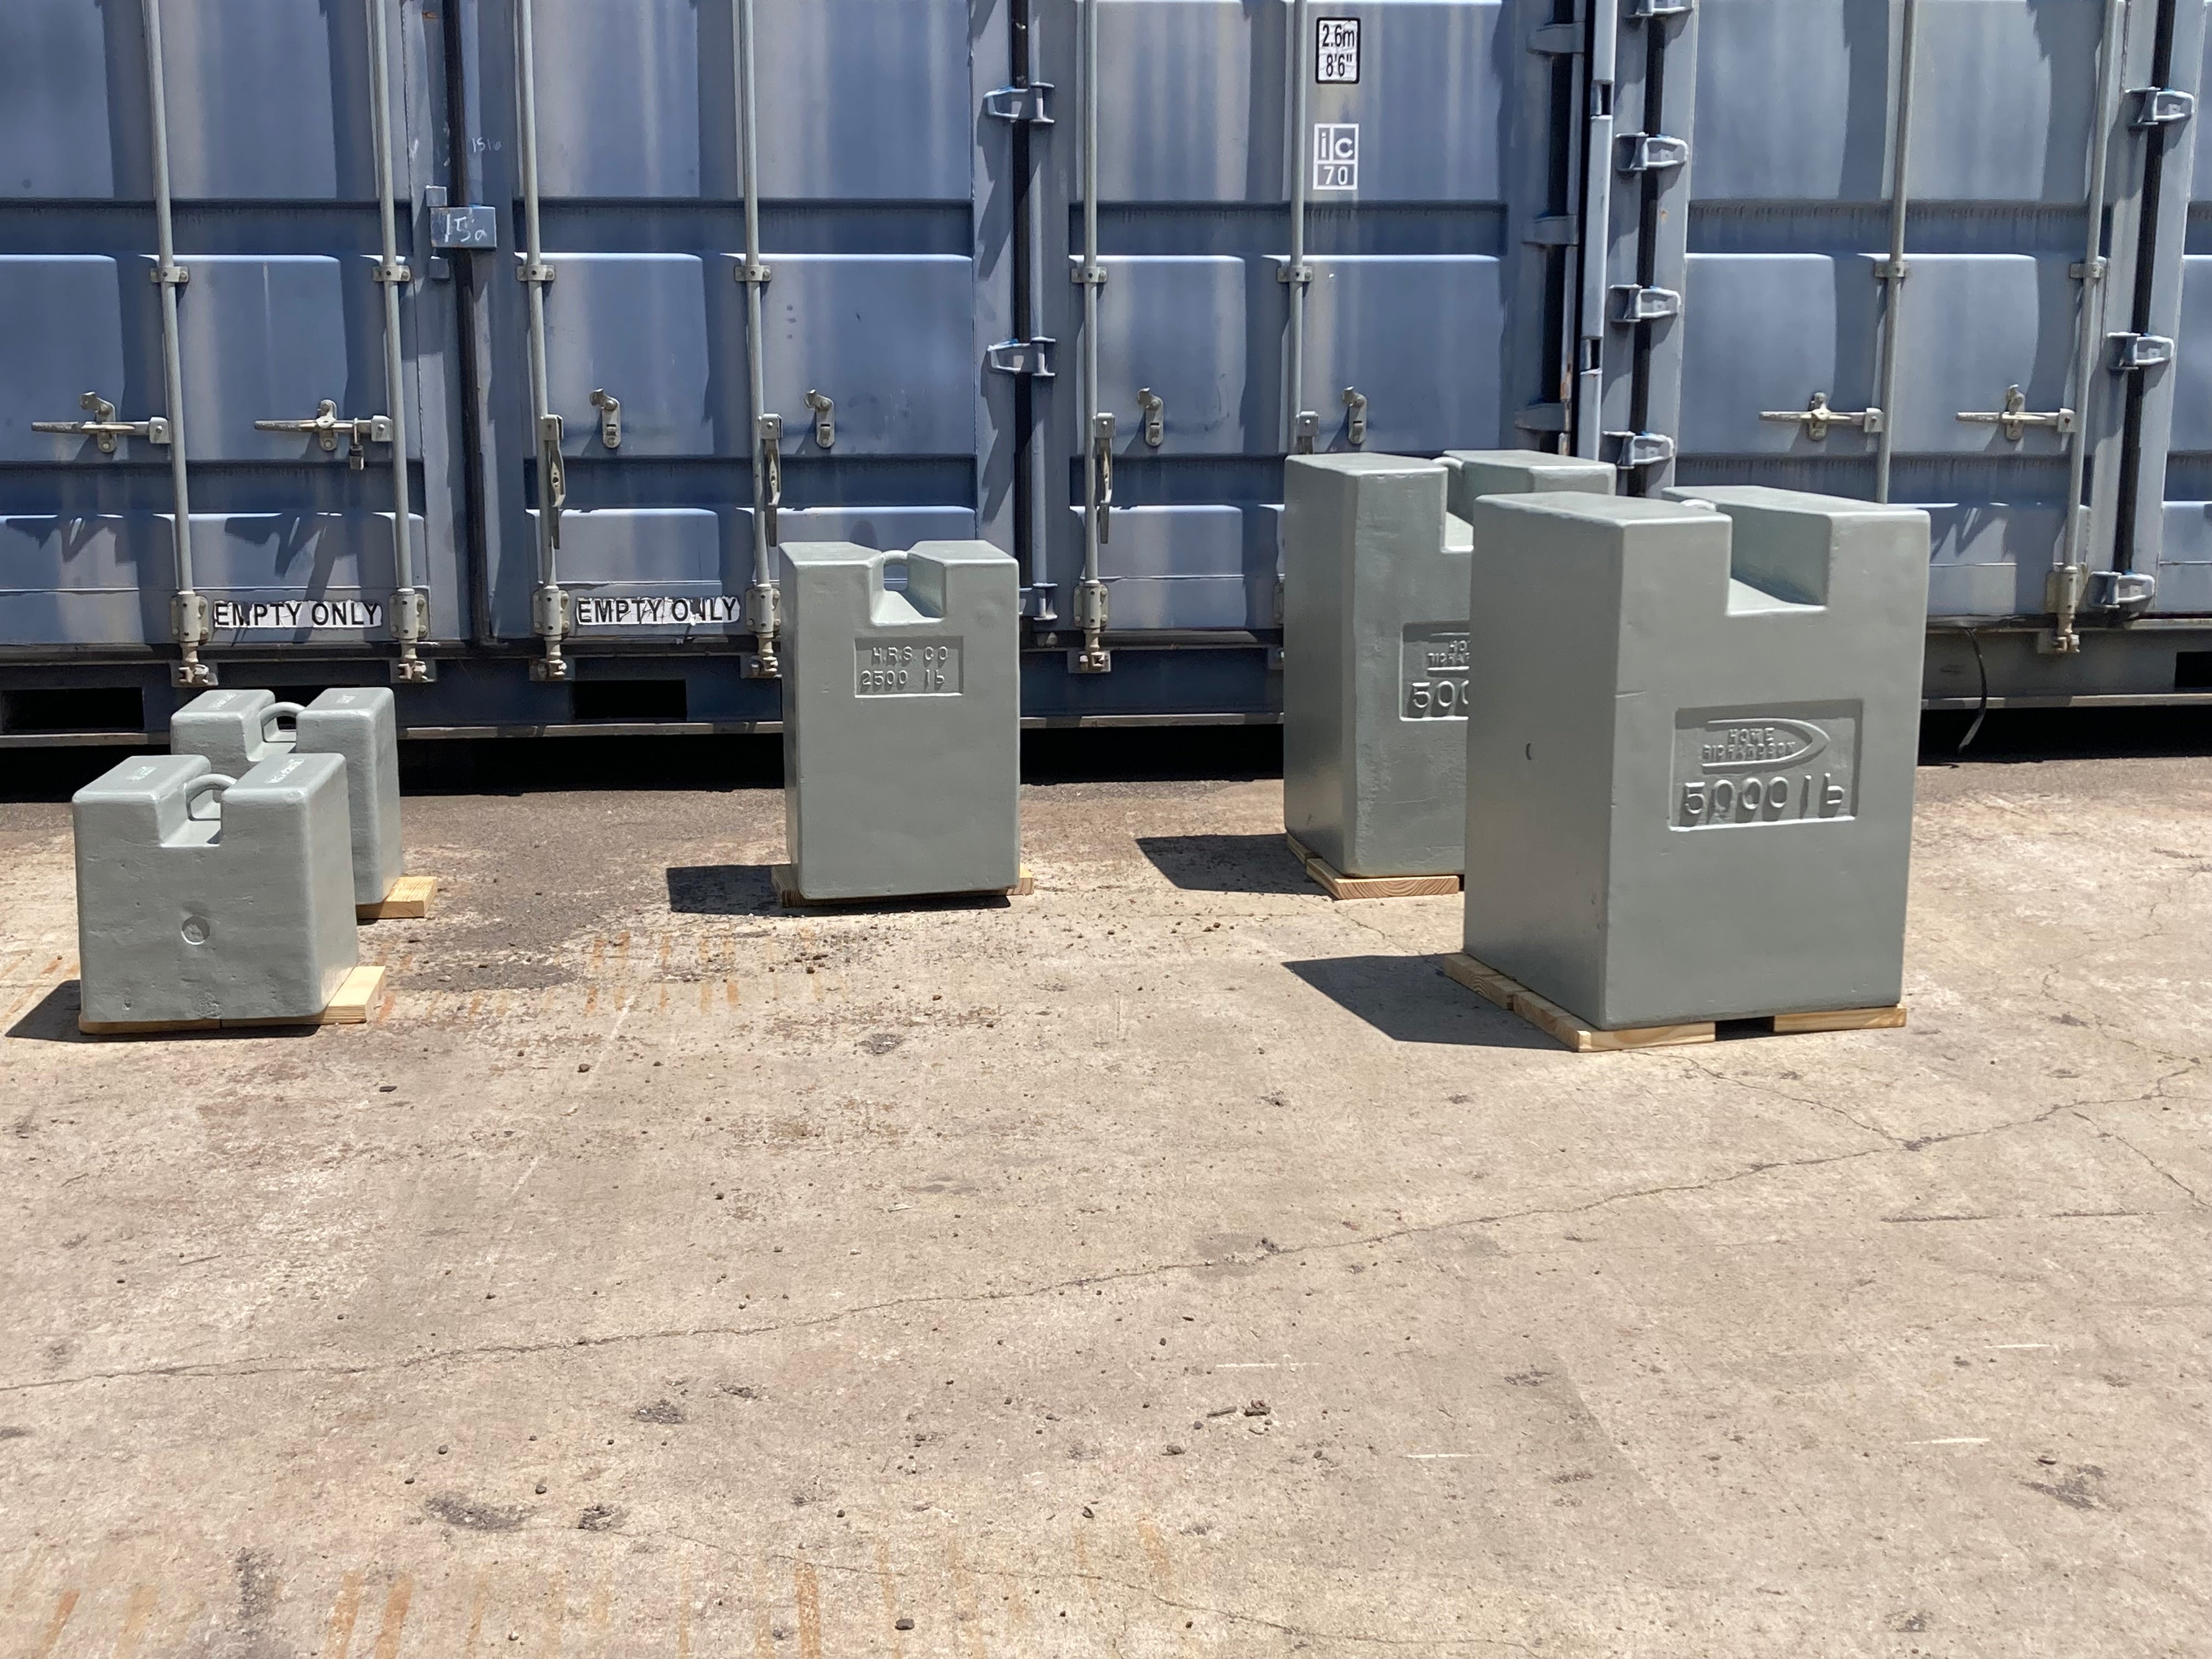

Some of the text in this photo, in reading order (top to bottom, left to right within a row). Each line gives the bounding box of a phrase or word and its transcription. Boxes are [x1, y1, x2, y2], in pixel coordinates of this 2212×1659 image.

[1322, 24, 1355, 47] 2.6m
[1326, 53, 1353, 77] 8'6"
[1323, 165, 1348, 185] 70
[311, 602, 377, 626] ONLY
[578, 599, 662, 623] EMPTY
[860, 669, 909, 686] 2500
[1684, 776, 1790, 815] 5000
